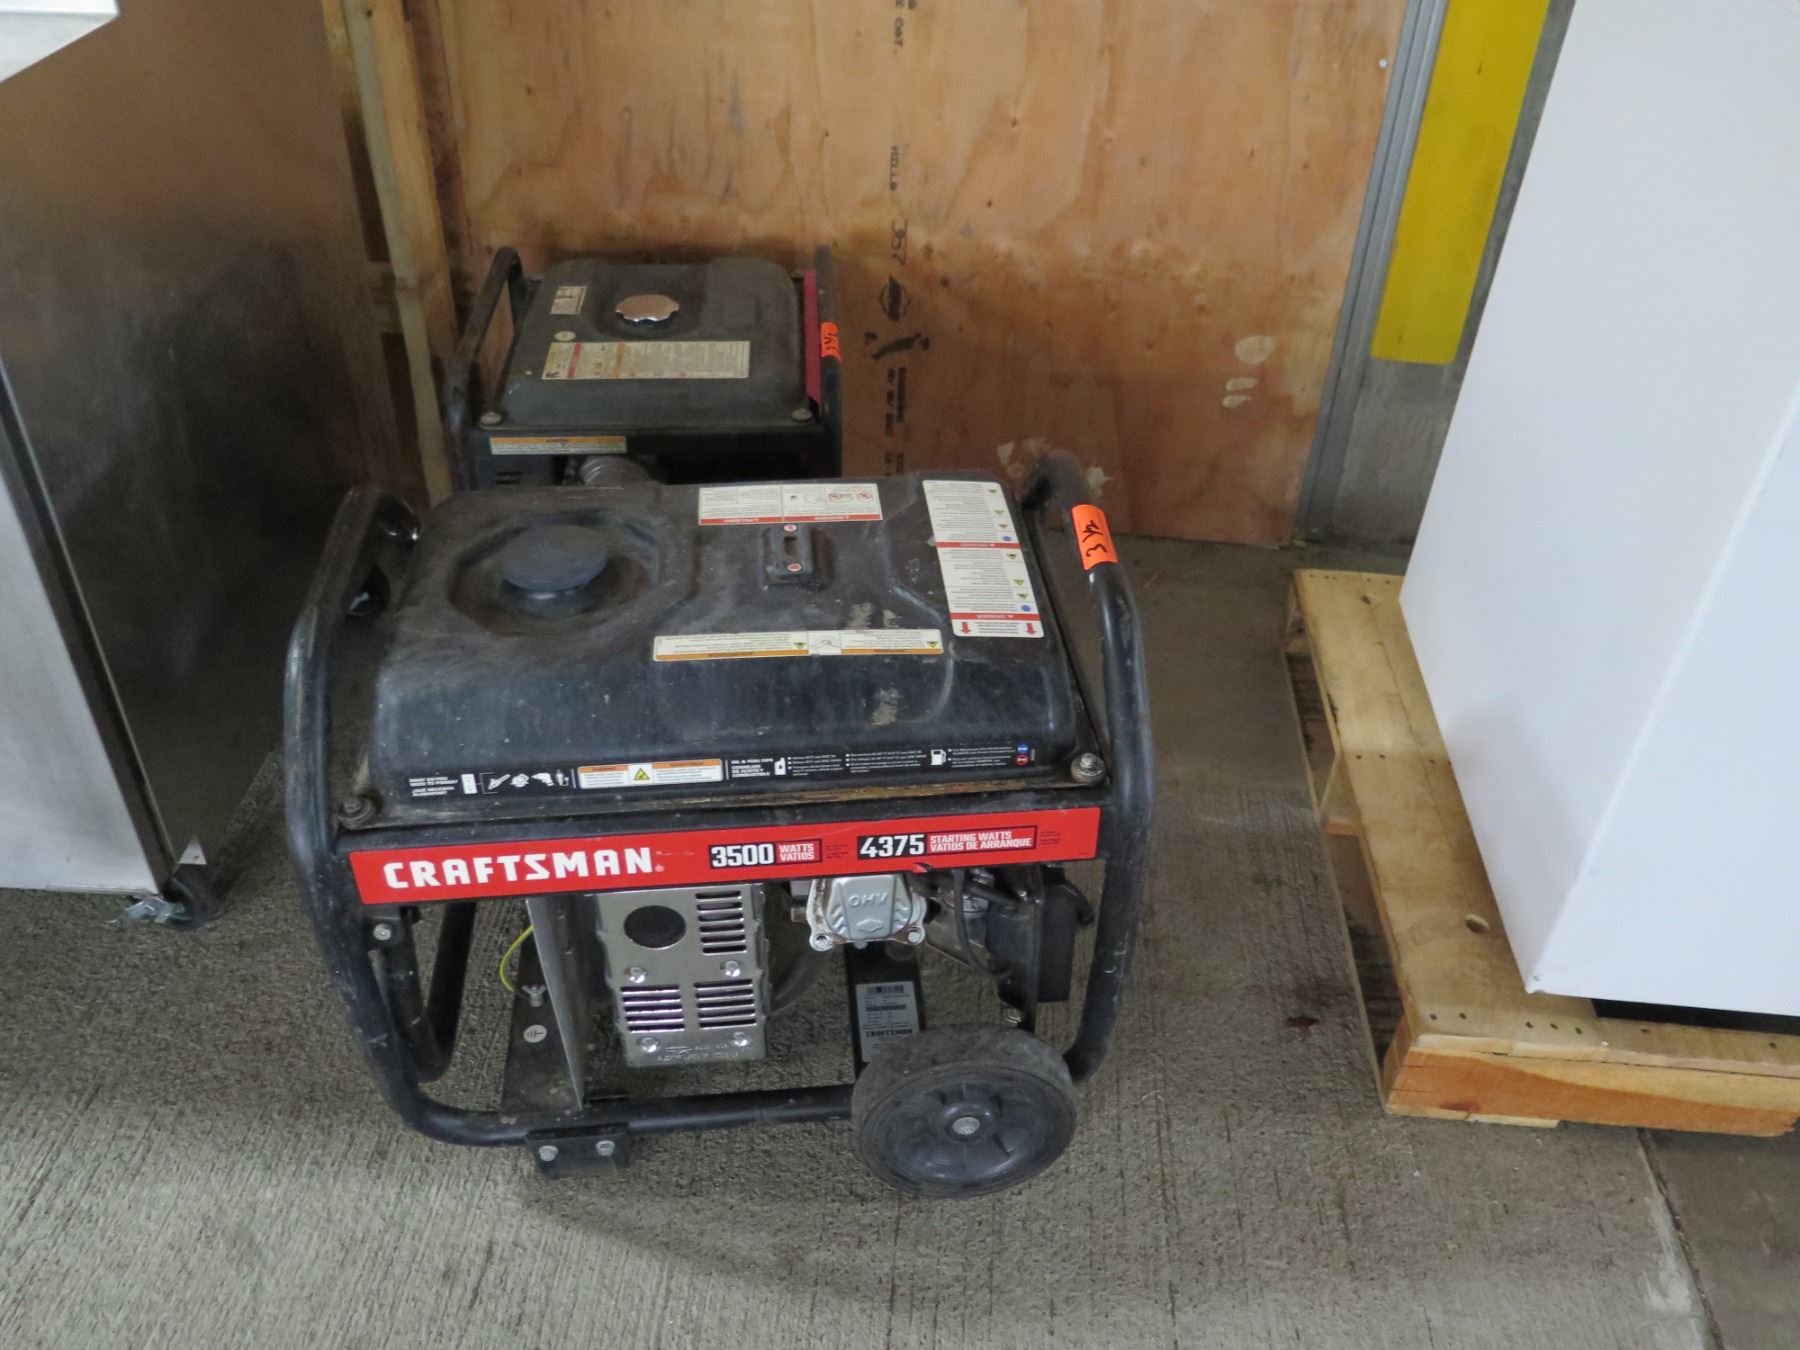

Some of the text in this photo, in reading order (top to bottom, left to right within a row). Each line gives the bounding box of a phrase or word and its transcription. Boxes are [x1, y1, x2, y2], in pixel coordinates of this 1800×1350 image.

[930, 831, 1012, 845] STARTING WATTS
[930, 842, 964, 852] VATIOS
[966, 840, 978, 850] DE
[980, 838, 1032, 850] ARRANQUE
[779, 843, 814, 853] WATTS
[860, 834, 925, 858] 4375
[711, 843, 775, 868] 3500
[780, 851, 815, 862] VATIOS
[383, 847, 653, 889] CRAFTSMAN
